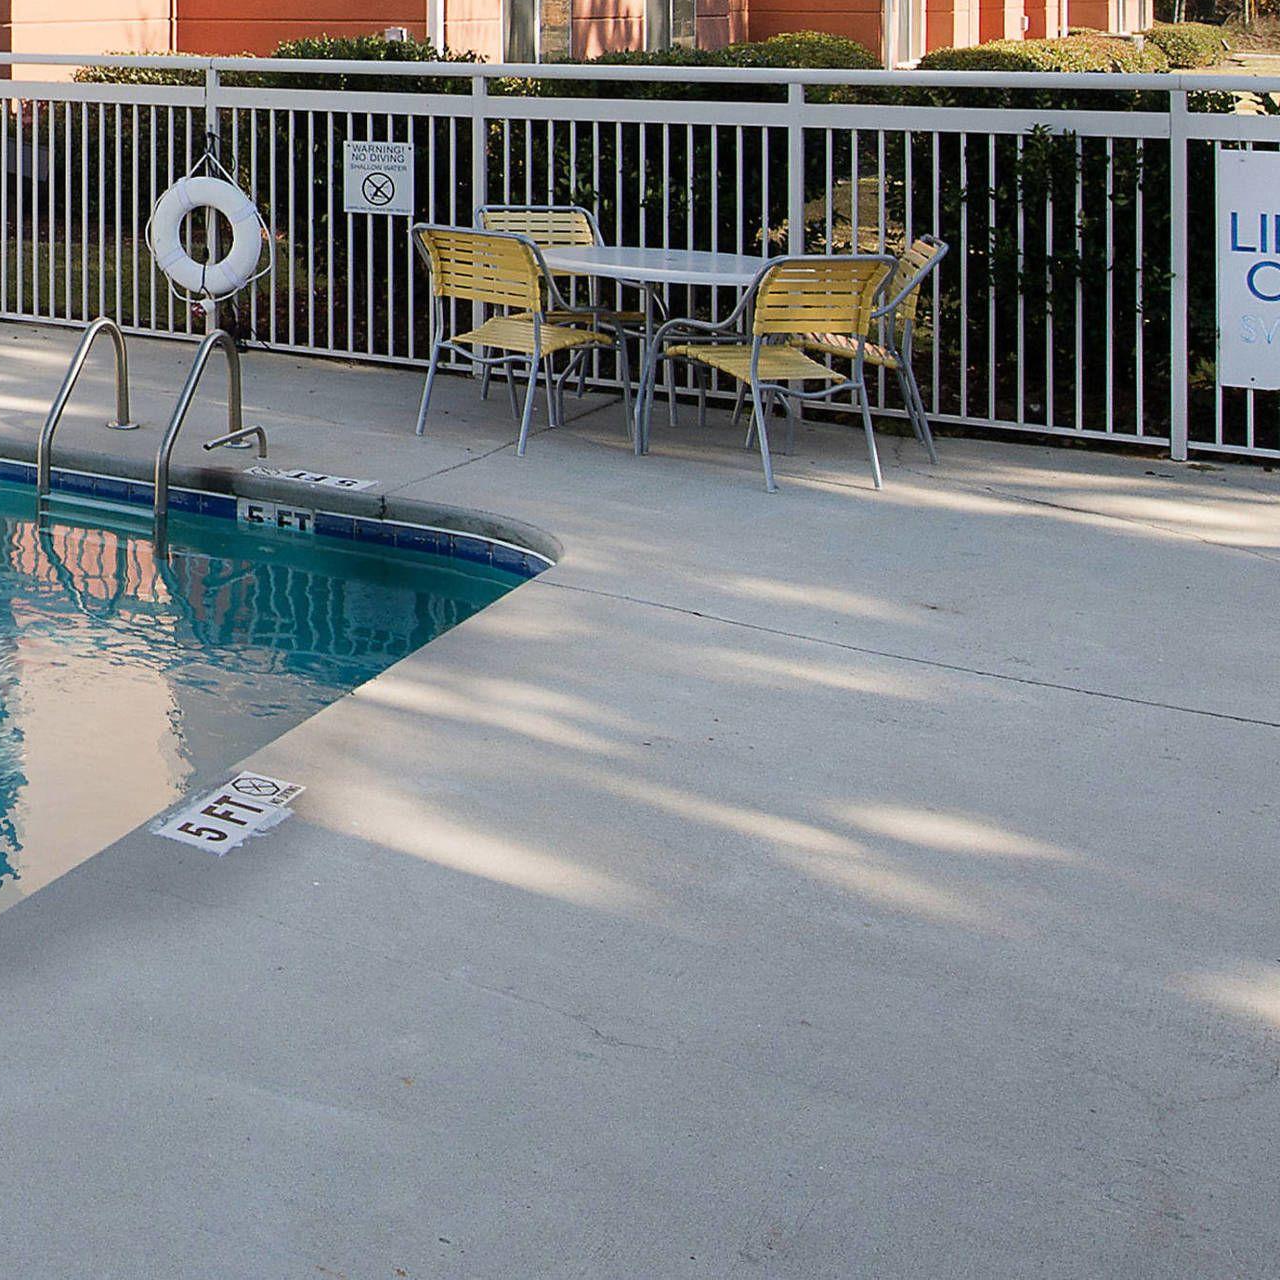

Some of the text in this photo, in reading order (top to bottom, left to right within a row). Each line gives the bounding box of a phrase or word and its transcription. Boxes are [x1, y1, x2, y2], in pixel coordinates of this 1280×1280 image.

[351, 144, 406, 155] WARNING!
[351, 153, 406, 163] NO DIVING
[1230, 211, 1280, 254] LI
[177, 794, 265, 842] 5 FT
